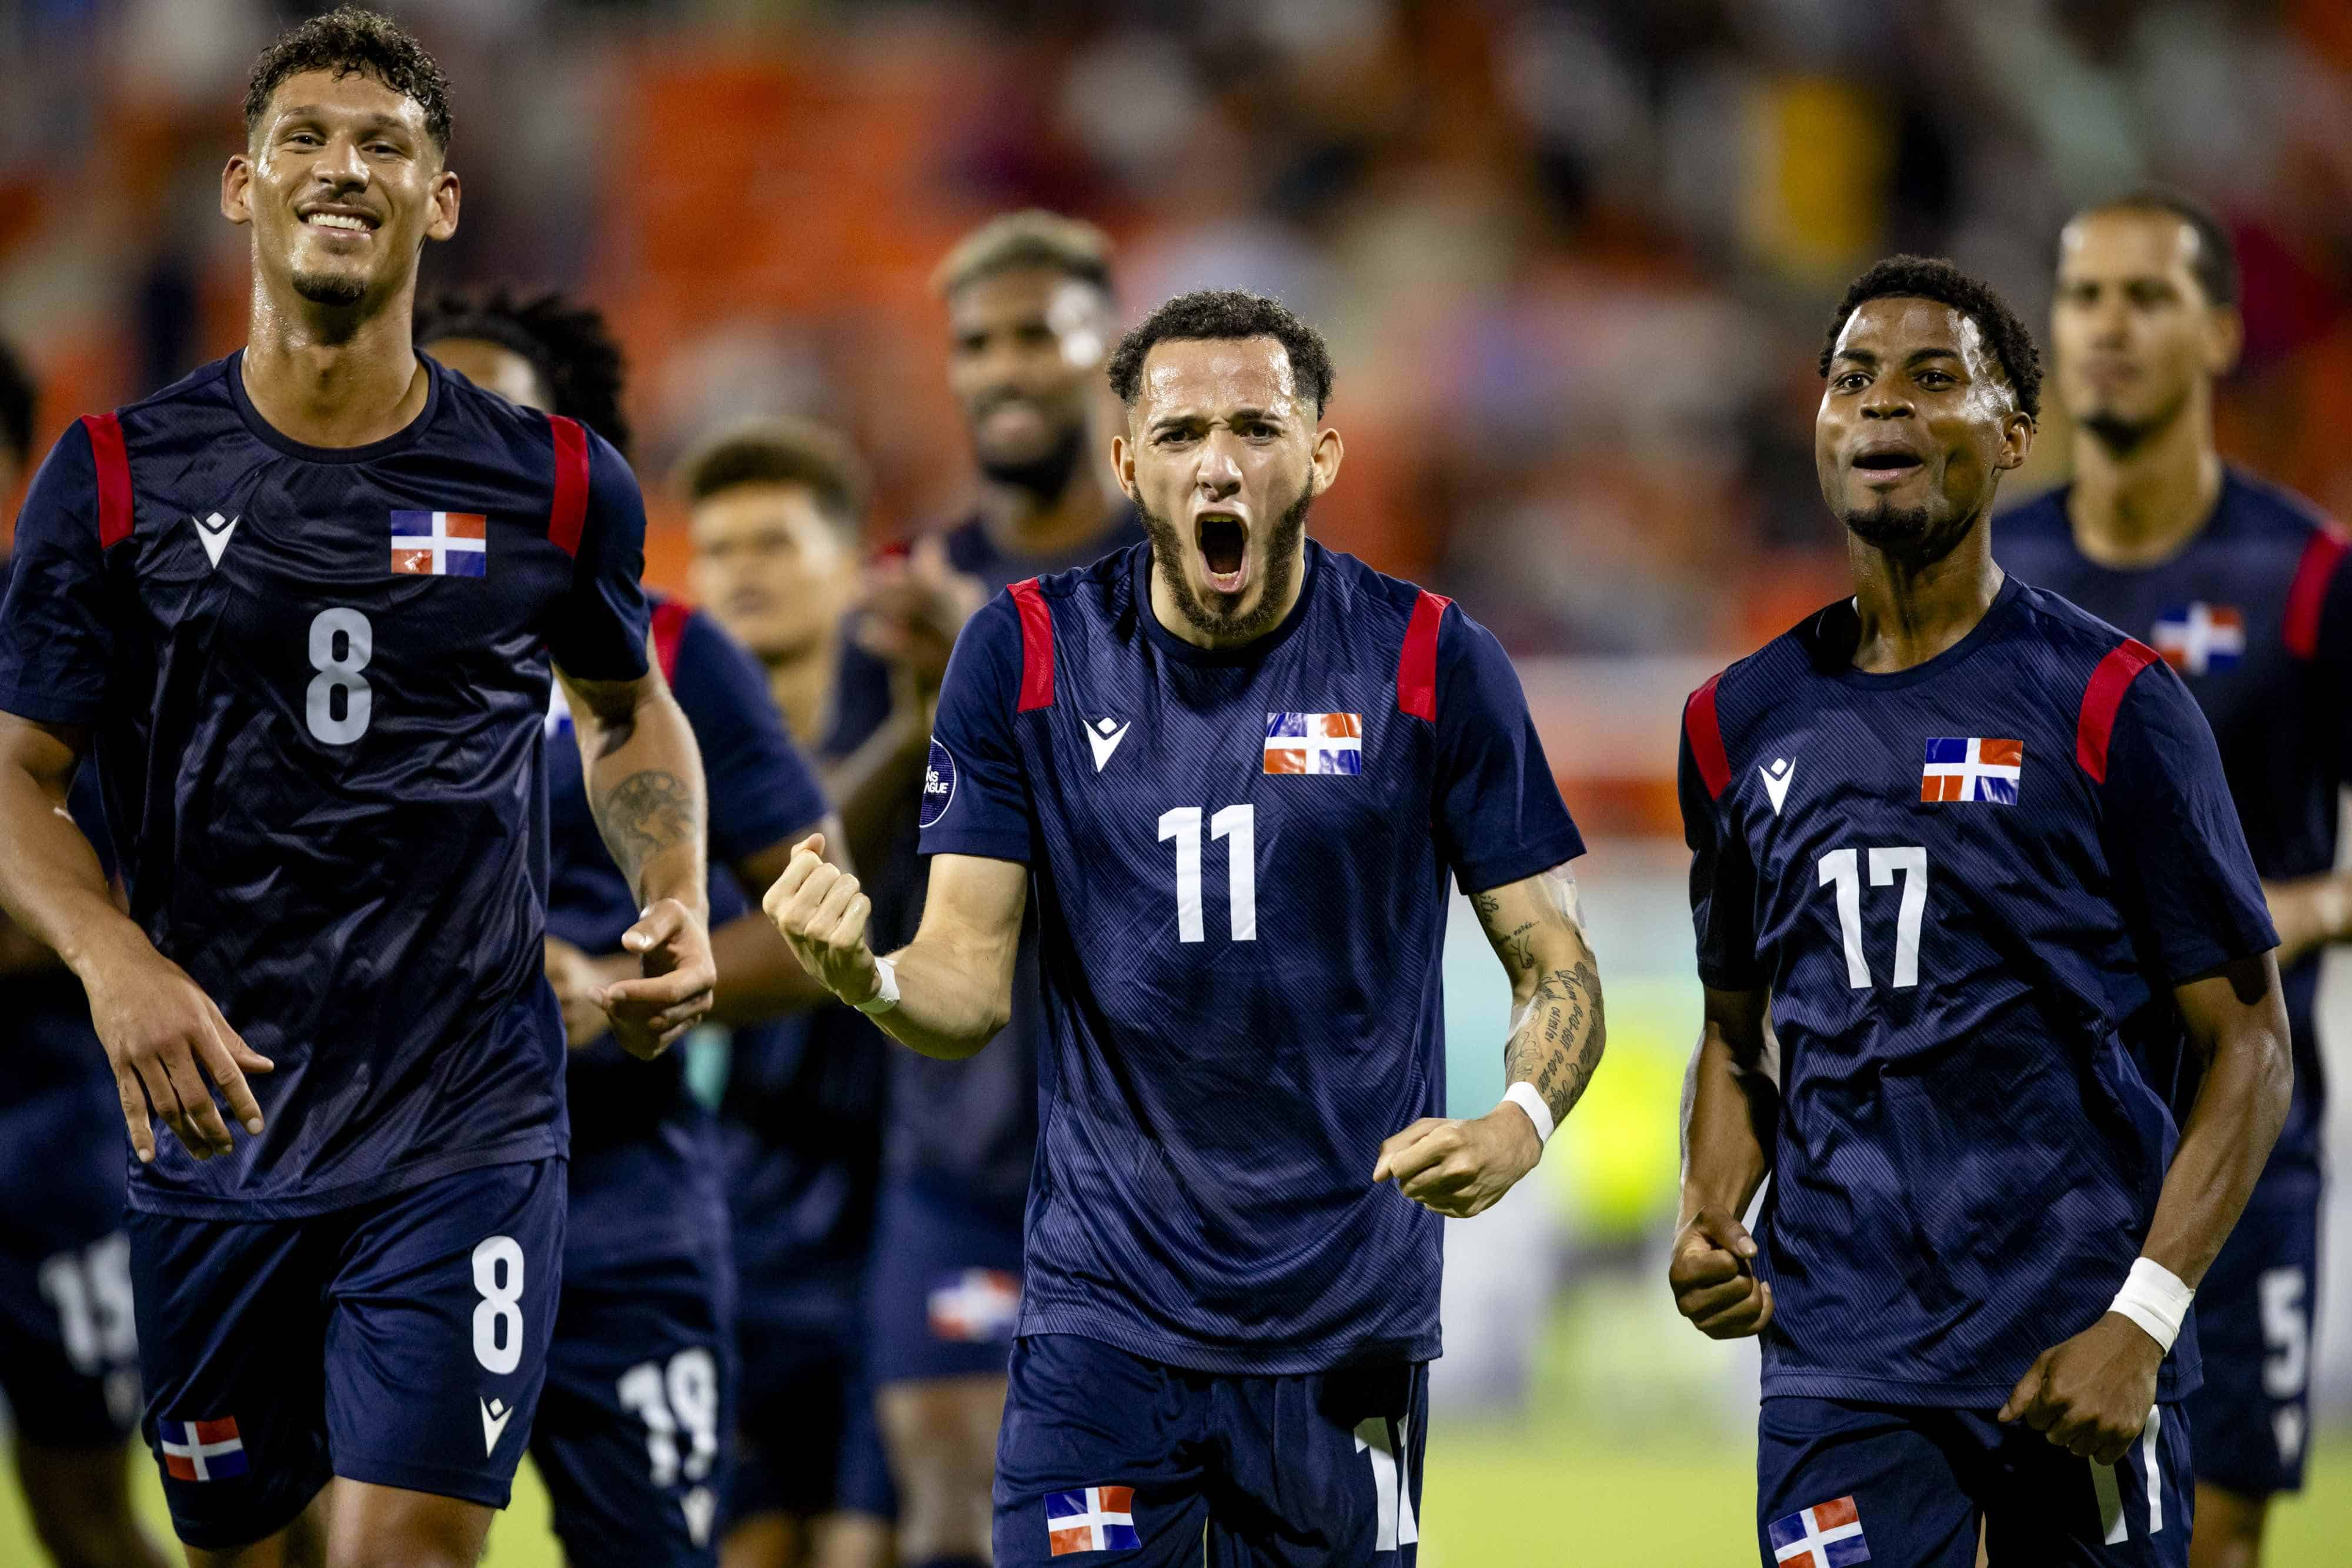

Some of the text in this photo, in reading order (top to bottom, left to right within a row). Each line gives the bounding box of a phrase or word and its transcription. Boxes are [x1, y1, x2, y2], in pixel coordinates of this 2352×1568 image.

[306, 607, 372, 745] 8
[1158, 804, 1257, 943] 11
[1818, 846, 1927, 989] 17
[472, 1236, 524, 1375] 8
[2259, 1266, 2307, 1399] 5
[617, 1348, 719, 1488] 19
